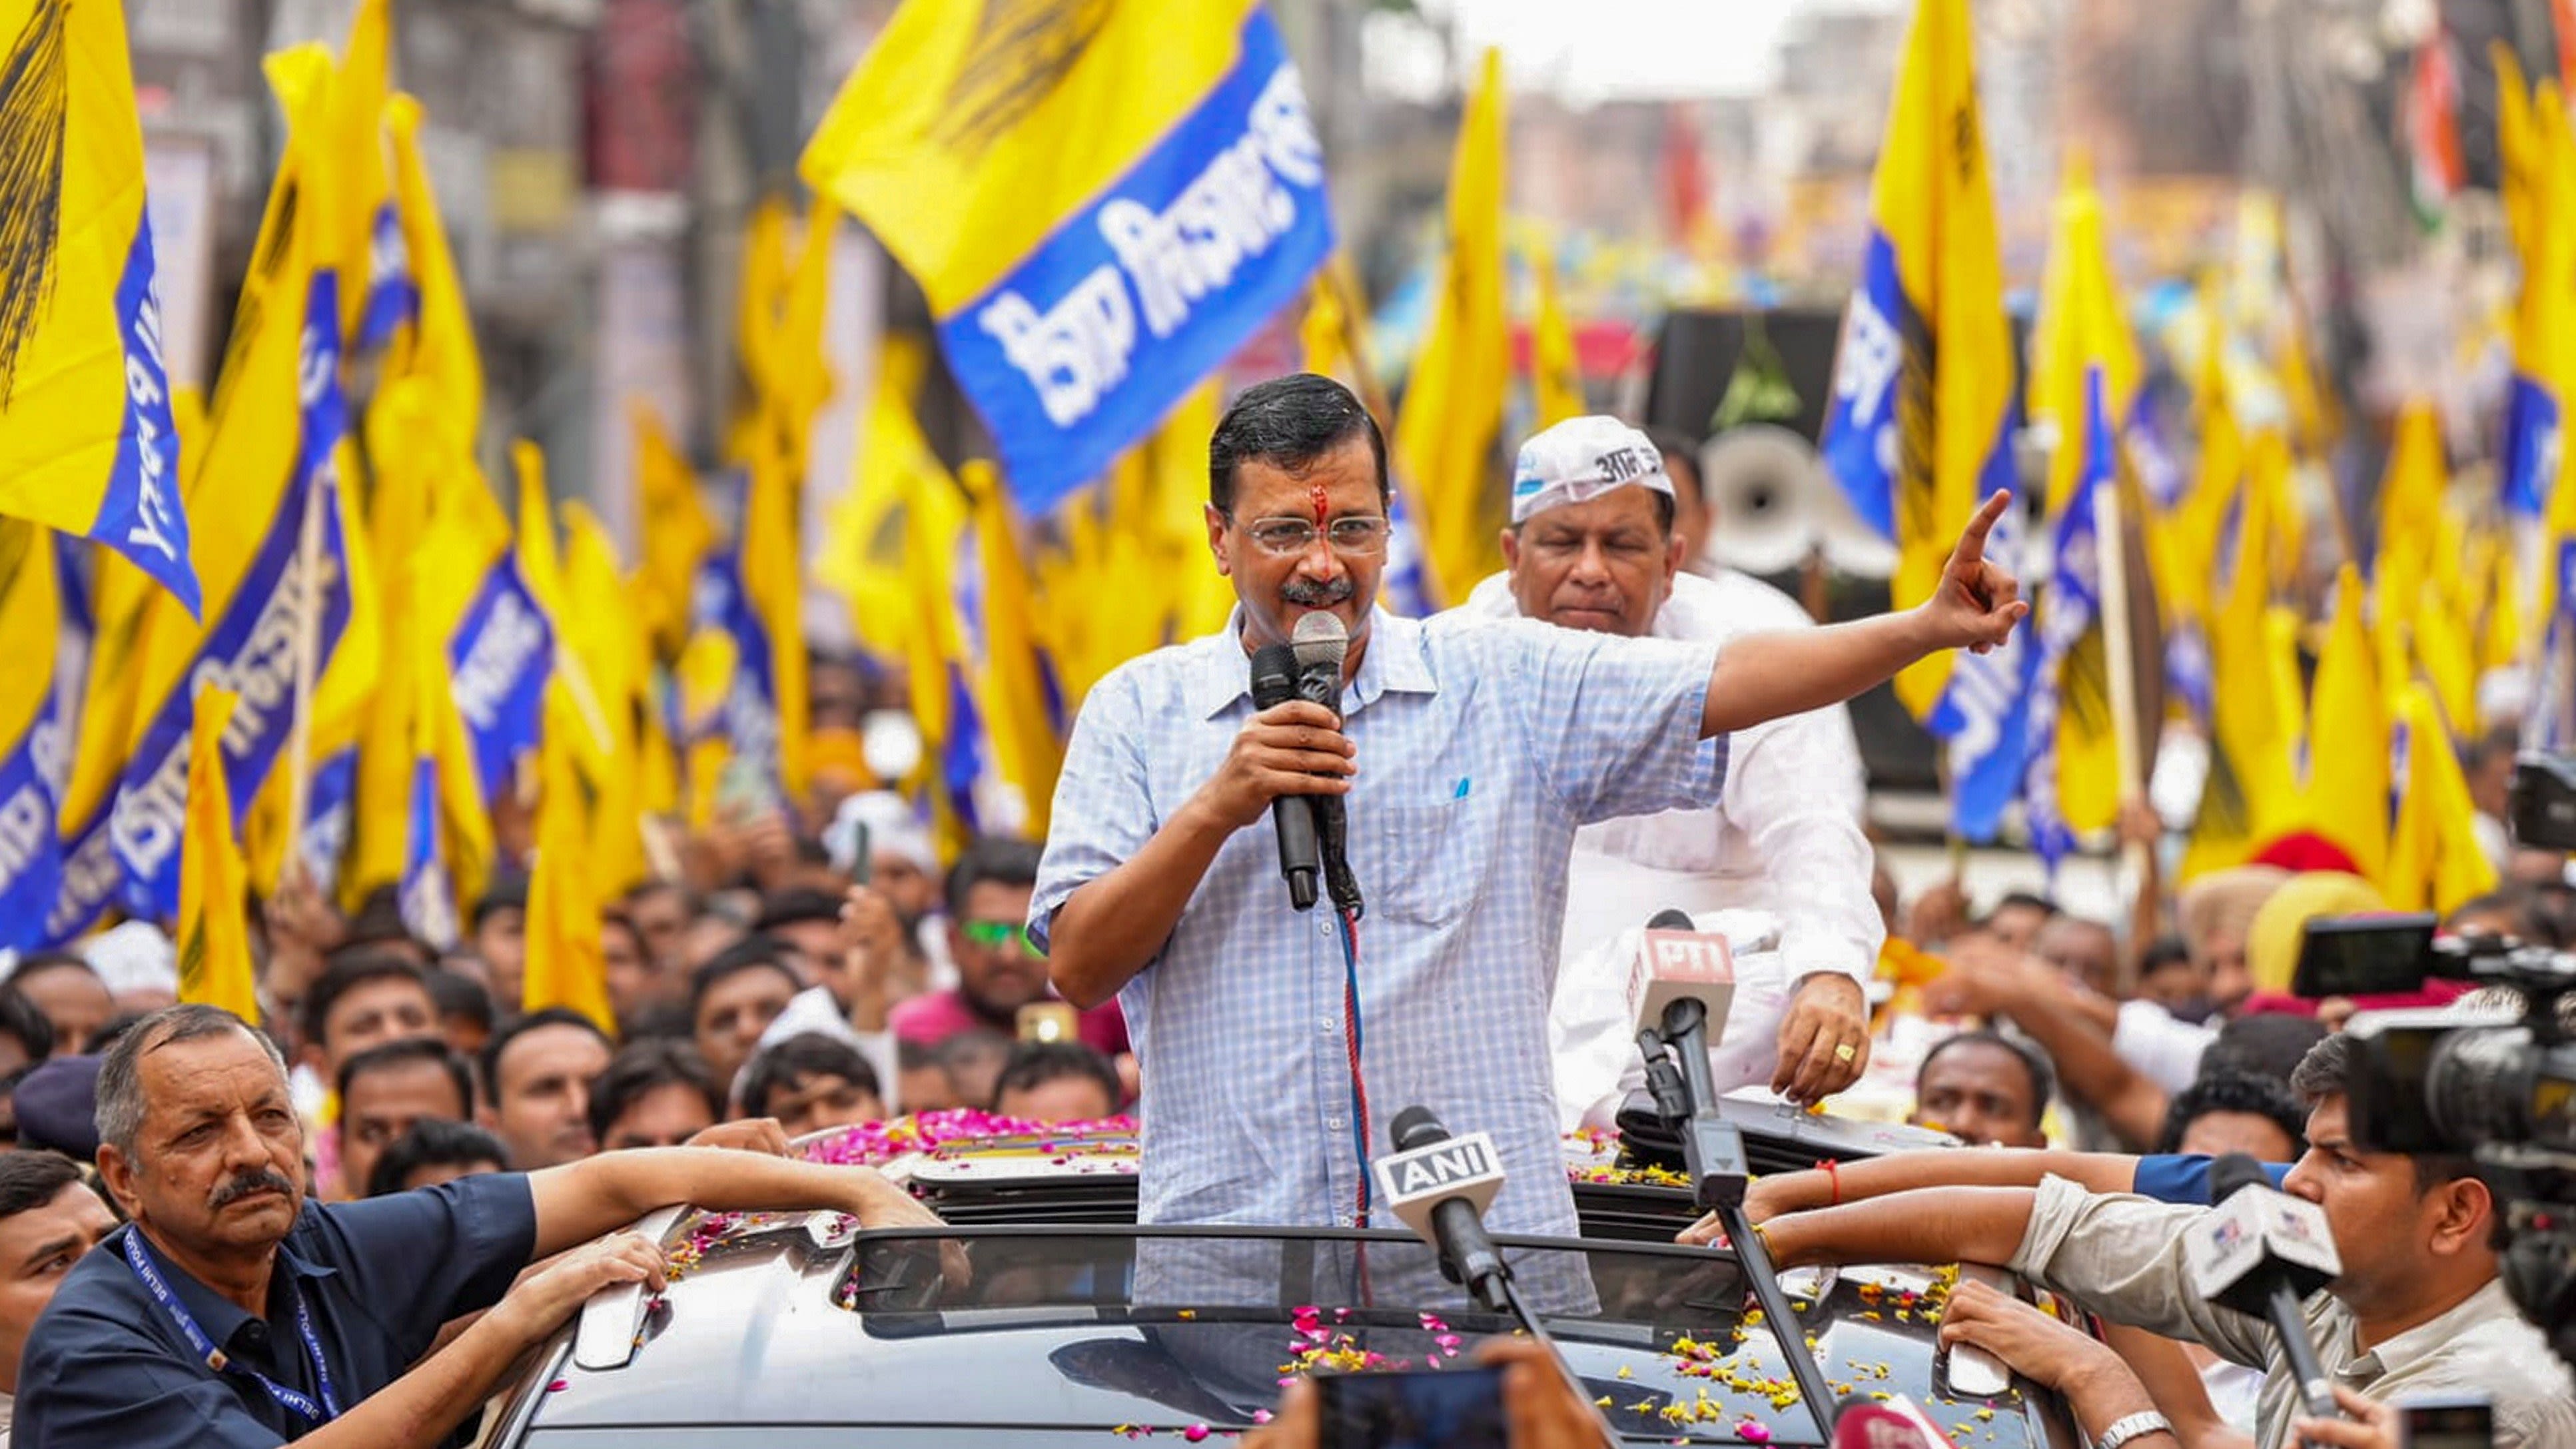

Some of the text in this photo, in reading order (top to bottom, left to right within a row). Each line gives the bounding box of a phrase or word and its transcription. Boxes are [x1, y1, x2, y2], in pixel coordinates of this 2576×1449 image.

[1655, 939, 1725, 971] PTI
[1403, 1145, 1484, 1193] ANI
[141, 1266, 167, 1302] DELHI
[282, 1392, 320, 1420] DELHI
